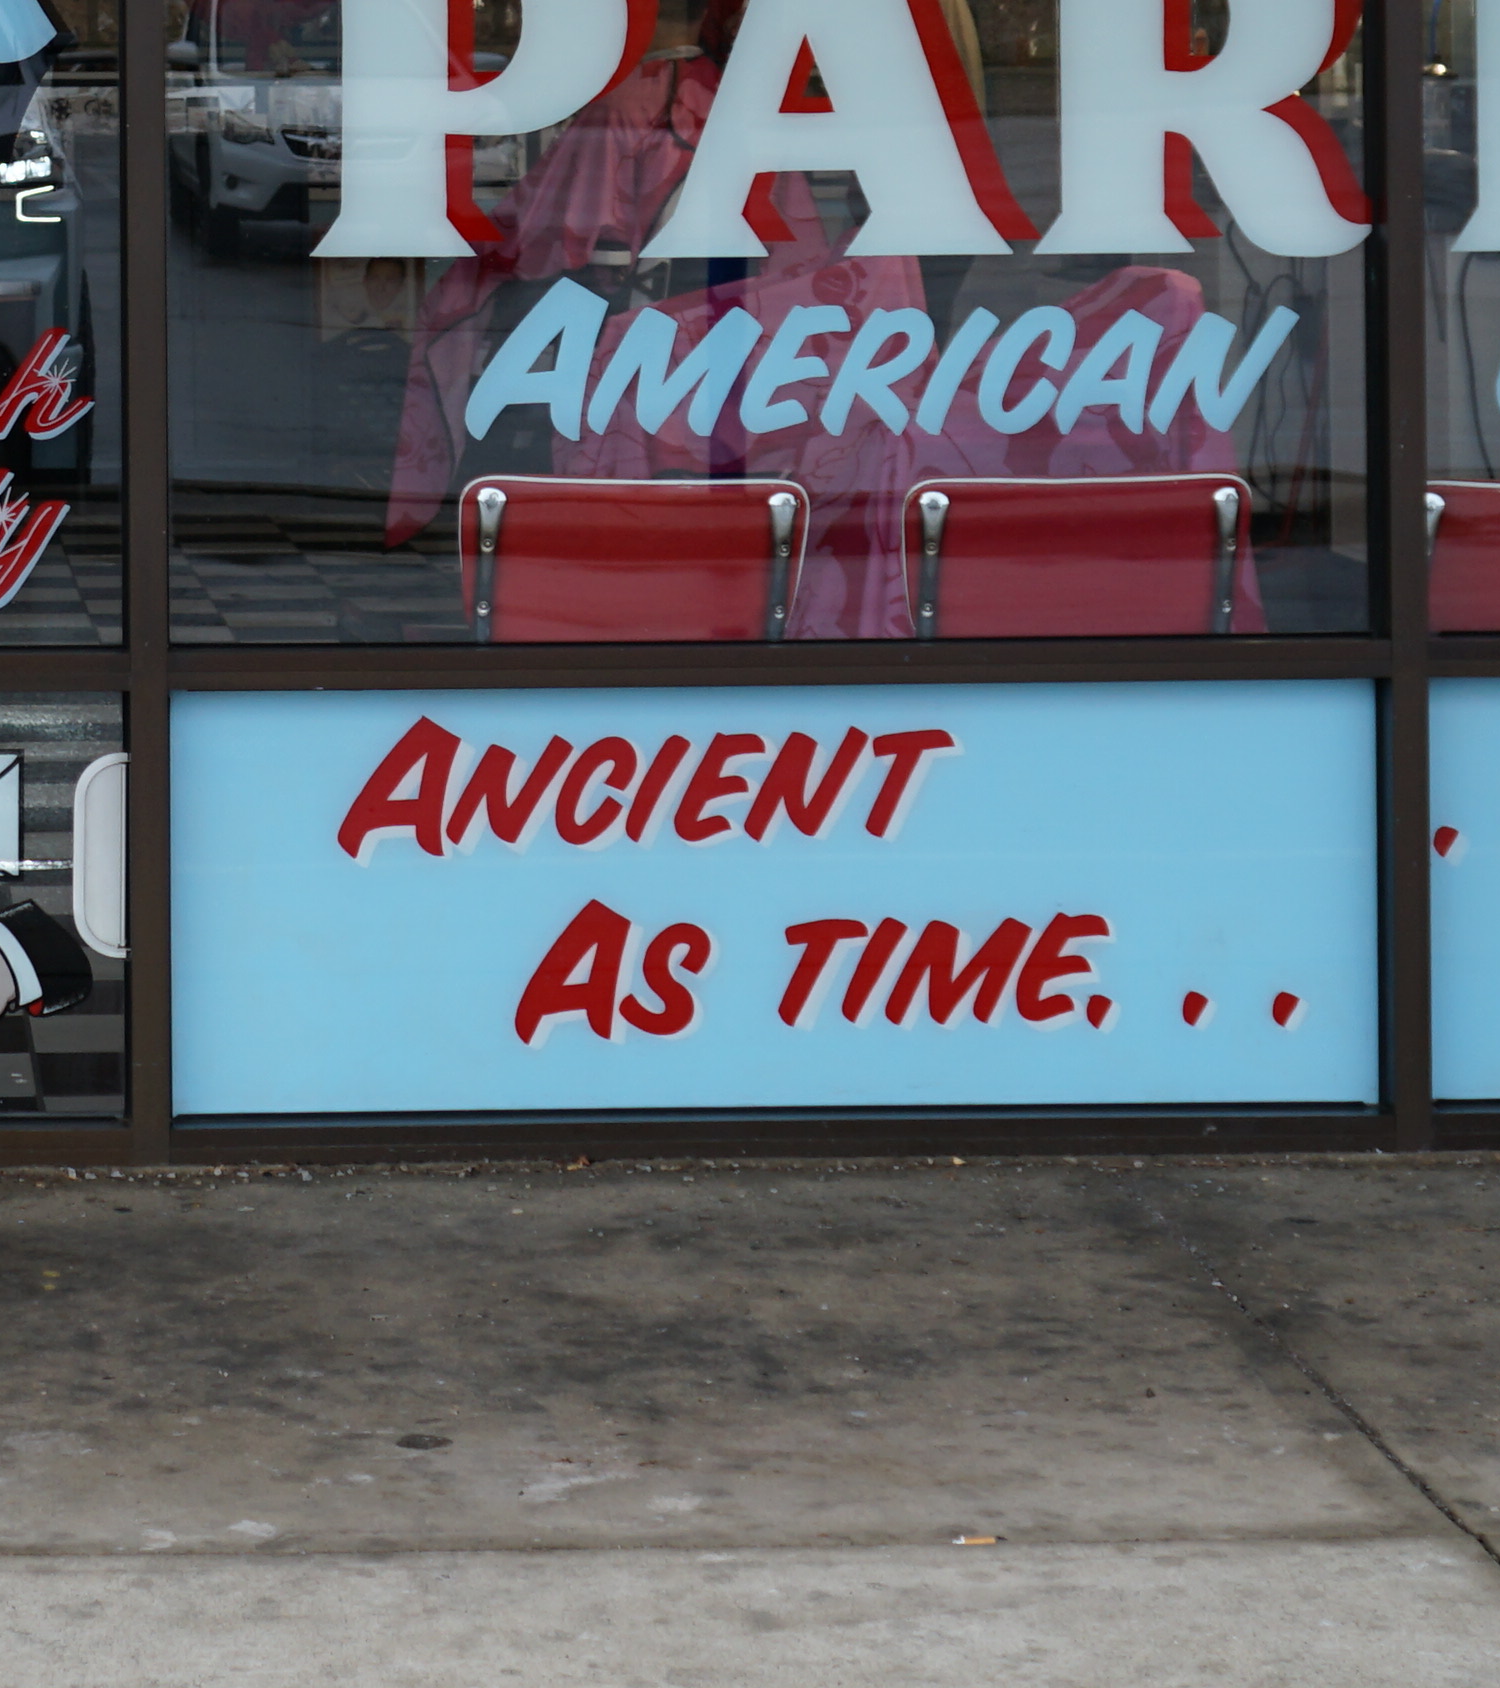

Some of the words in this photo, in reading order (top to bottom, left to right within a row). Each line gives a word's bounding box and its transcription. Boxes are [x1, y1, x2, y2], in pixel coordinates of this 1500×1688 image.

[464, 276, 1300, 442] AMERICAN
[337, 715, 963, 864] ANCIENT
[513, 898, 717, 1050] AS
